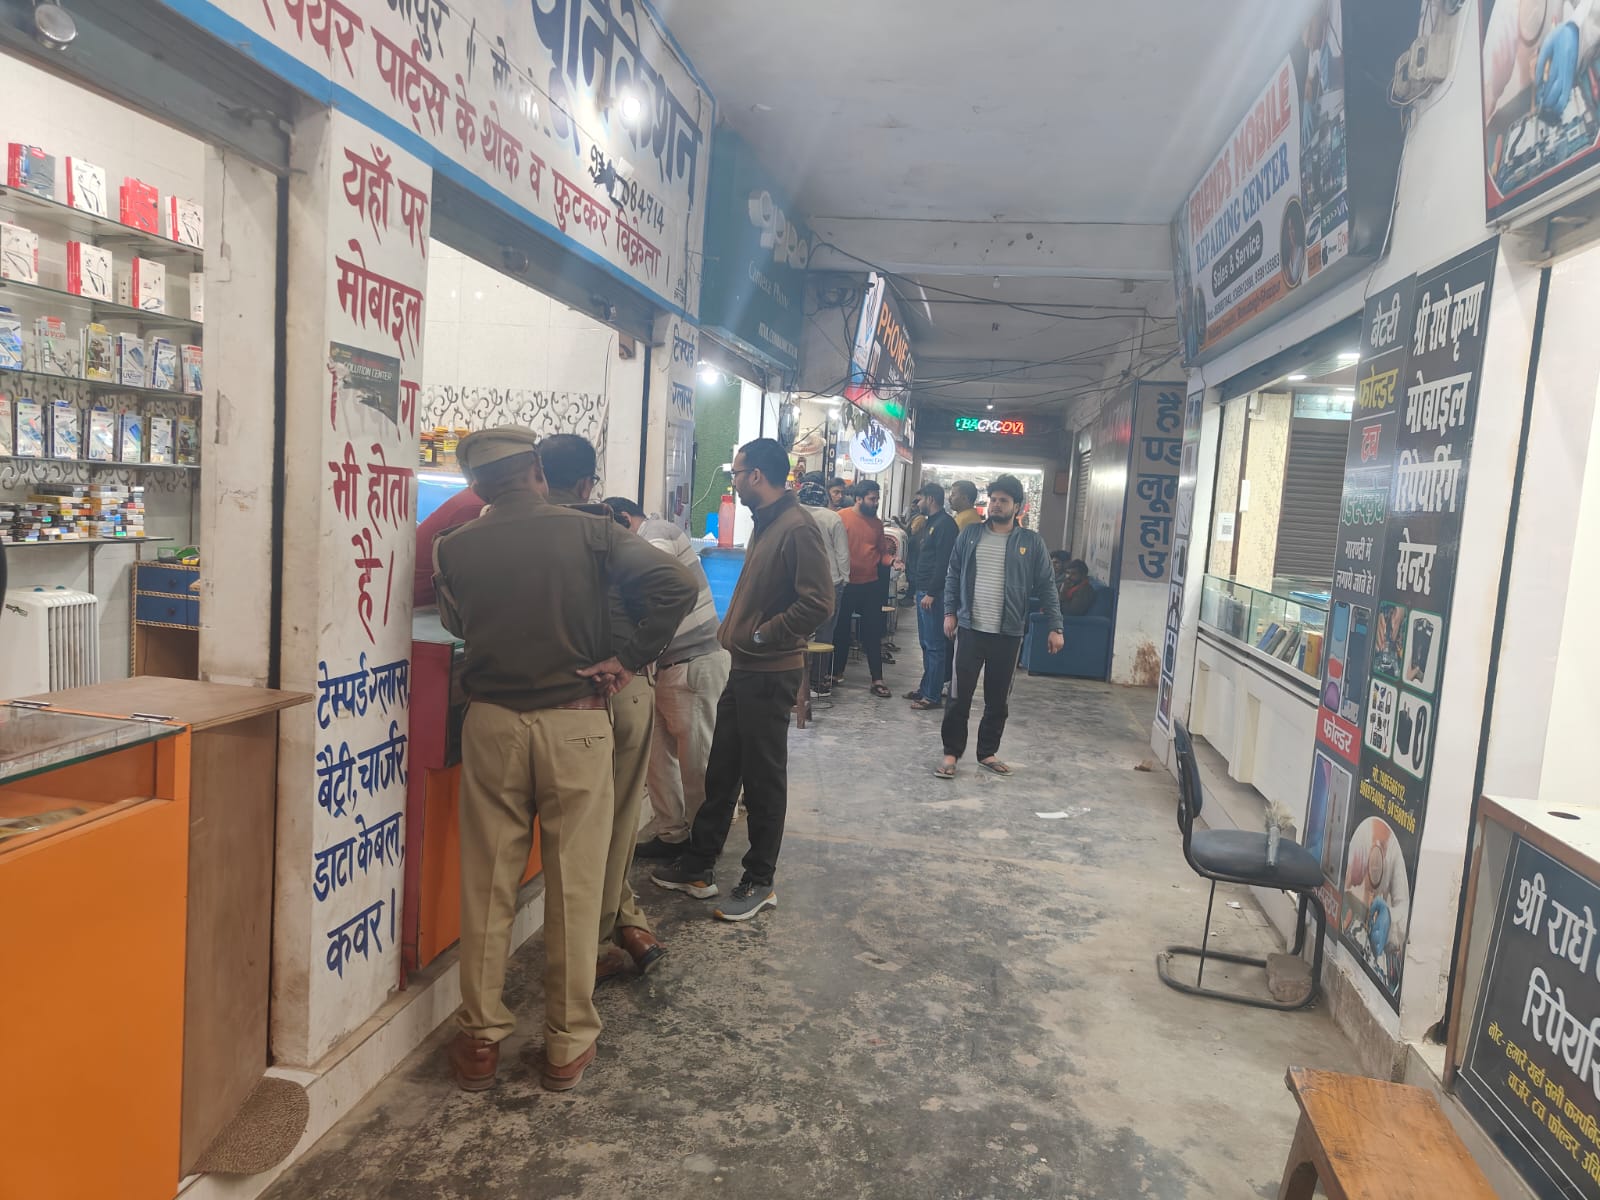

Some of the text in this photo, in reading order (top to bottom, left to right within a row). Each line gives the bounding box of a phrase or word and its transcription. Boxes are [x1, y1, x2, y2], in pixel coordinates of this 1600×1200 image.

[370, 26, 450, 137] पार्ट्स
[454, 72, 477, 154] के
[480, 99, 523, 185] थोक
[530, 150, 546, 203] व
[551, 166, 611, 247] फुटकर
[1233, 64, 1292, 188] MOBILE
[342, 143, 429, 259] यहाँ पर
[1196, 197, 1241, 274] REPAIRING
[1242, 141, 1290, 223] CENTER
[335, 238, 424, 362] मोबाइल
[1213, 233, 1261, 289] Sales & Service
[876, 302, 909, 373] PHONE
[1412, 291, 1431, 357] श्री
[1429, 282, 1452, 352] राधे
[1450, 280, 1486, 362] कृष्ण
[1359, 363, 1473, 437] फोल्डर मोबाइल
[328, 441, 415, 540] भी होता
[1396, 527, 1438, 596] सेन्टर
[1323, 716, 1353, 753] फोल्डर
[313, 836, 357, 902] डाटा
[1513, 872, 1597, 974] श्री राधे
